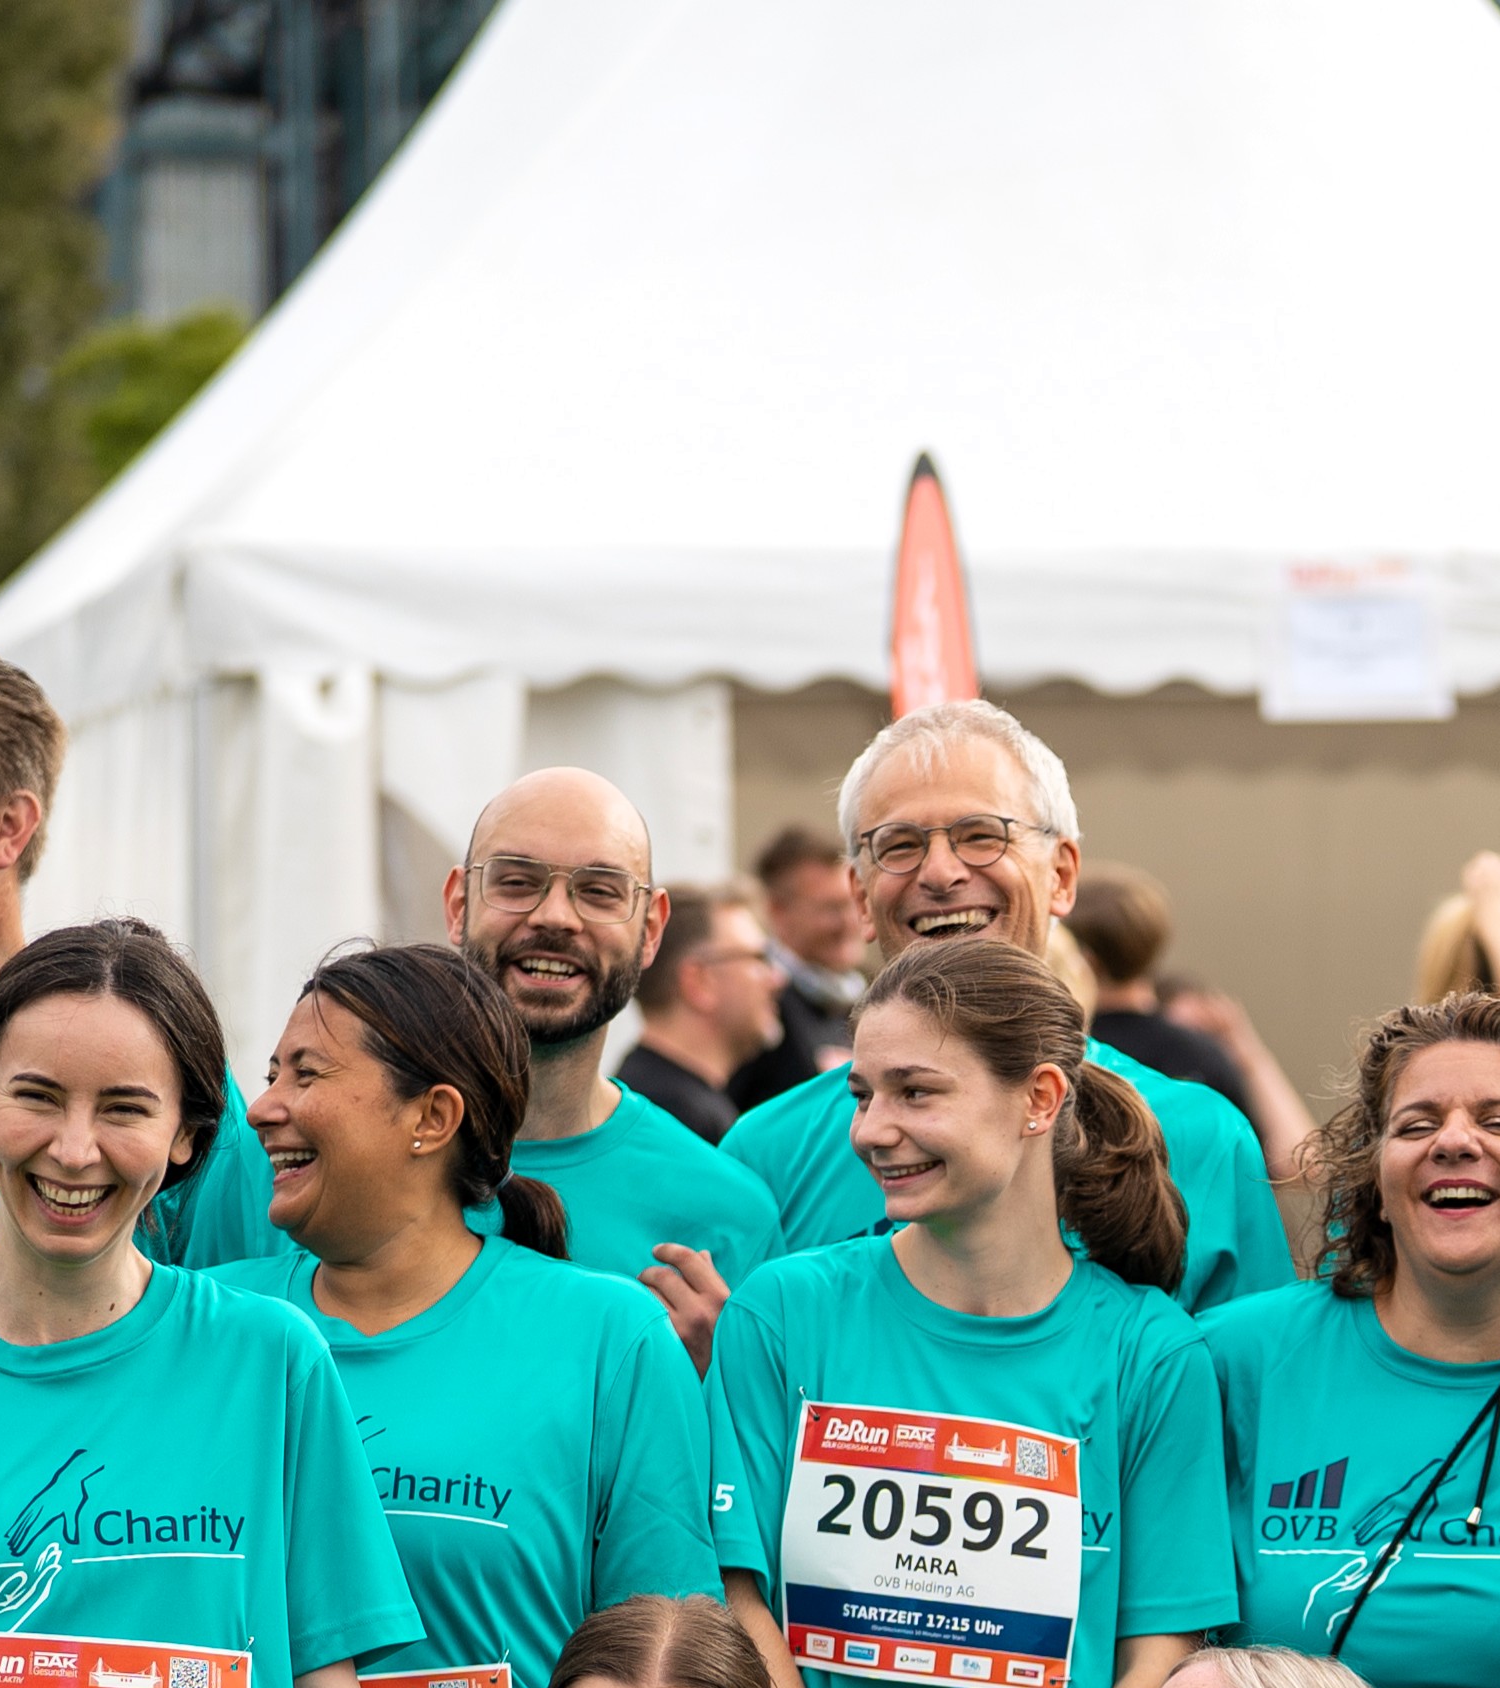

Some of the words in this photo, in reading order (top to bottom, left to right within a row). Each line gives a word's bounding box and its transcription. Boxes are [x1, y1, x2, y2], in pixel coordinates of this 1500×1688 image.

[824, 1418, 889, 1445] B2Run
[896, 1424, 935, 1442] DAK
[371, 1467, 512, 1518] Charity
[94, 1505, 245, 1551] Charity
[817, 1474, 1050, 1559] 20592
[1260, 1515, 1338, 1542] OVB
[895, 1553, 959, 1576] MARA
[874, 1575, 900, 1590] OVB
[905, 1578, 952, 1597] Holding
[956, 1585, 976, 1598] AG
[842, 1604, 920, 1625] STARTZEIT
[927, 1614, 971, 1632] 17:15
[975, 1619, 1004, 1636] Uhr
[33, 1651, 78, 1669] DAK
[33, 1667, 78, 1678] Gesundheit
